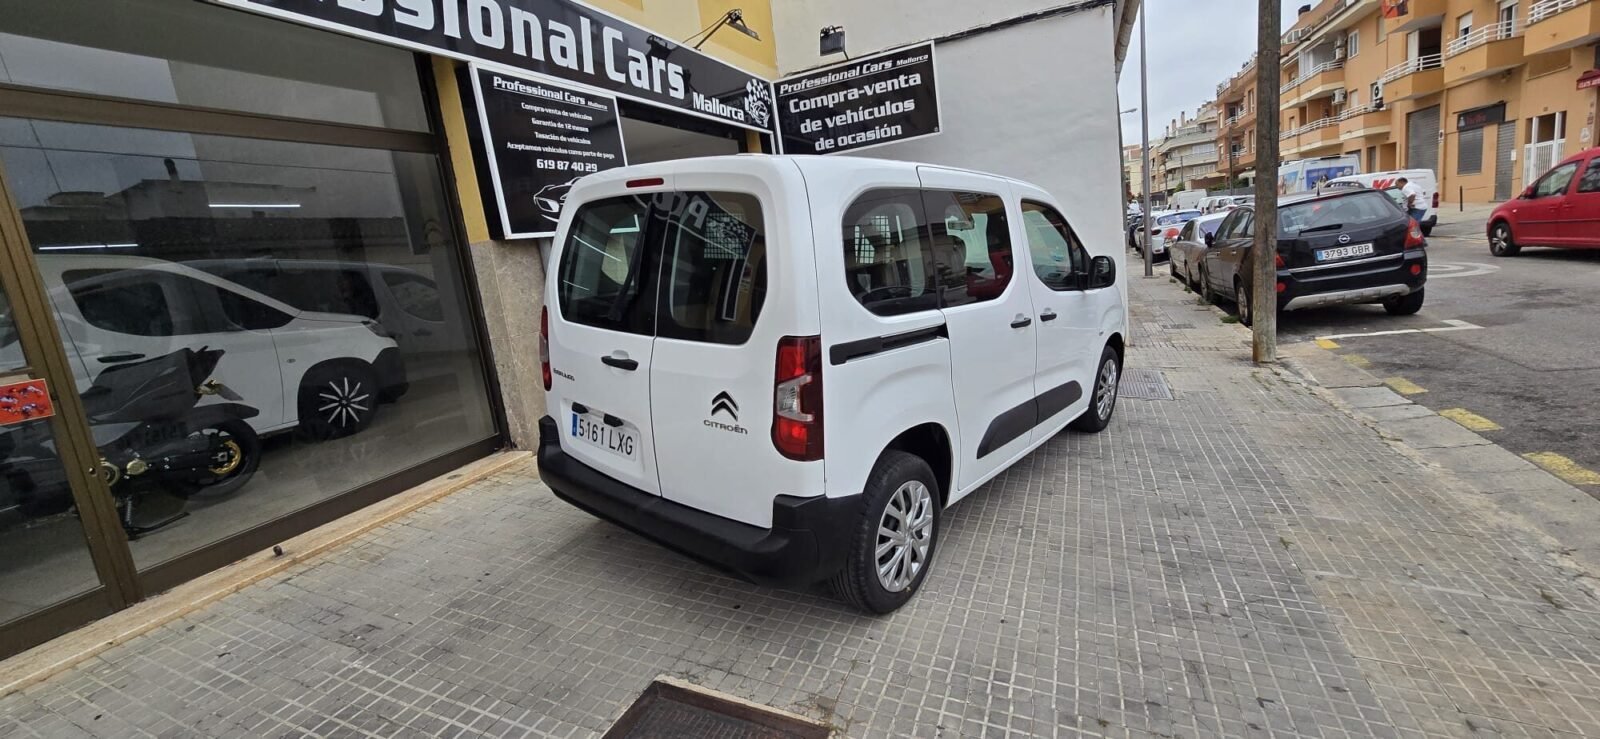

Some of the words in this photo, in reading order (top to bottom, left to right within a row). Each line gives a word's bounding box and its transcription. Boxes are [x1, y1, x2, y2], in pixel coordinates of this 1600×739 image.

[603, 25, 686, 100] Cars
[692, 91, 745, 122] Mallorca
[780, 66, 860, 94] Professional
[862, 60, 892, 75] Cars
[896, 54, 929, 67] Mallorca
[493, 76, 563, 101] Professional
[565, 92, 586, 105] Cars
[789, 72, 922, 113] Compra-venta
[521, 102, 561, 116] Compra-venta
[800, 119, 822, 134] de
[825, 98, 915, 128] vehículos
[507, 142, 541, 152] Aceptamos
[814, 137, 835, 151] de
[837, 123, 902, 147] ocasión
[536, 158, 556, 169] 619
[557, 160, 569, 171] 87
[571, 162, 584, 172] 40
[585, 163, 598, 173] 29
[1324, 247, 1349, 259] 3793
[1352, 244, 1371, 255] GBR
[578, 417, 605, 446] 5161
[608, 428, 633, 456] LXG
